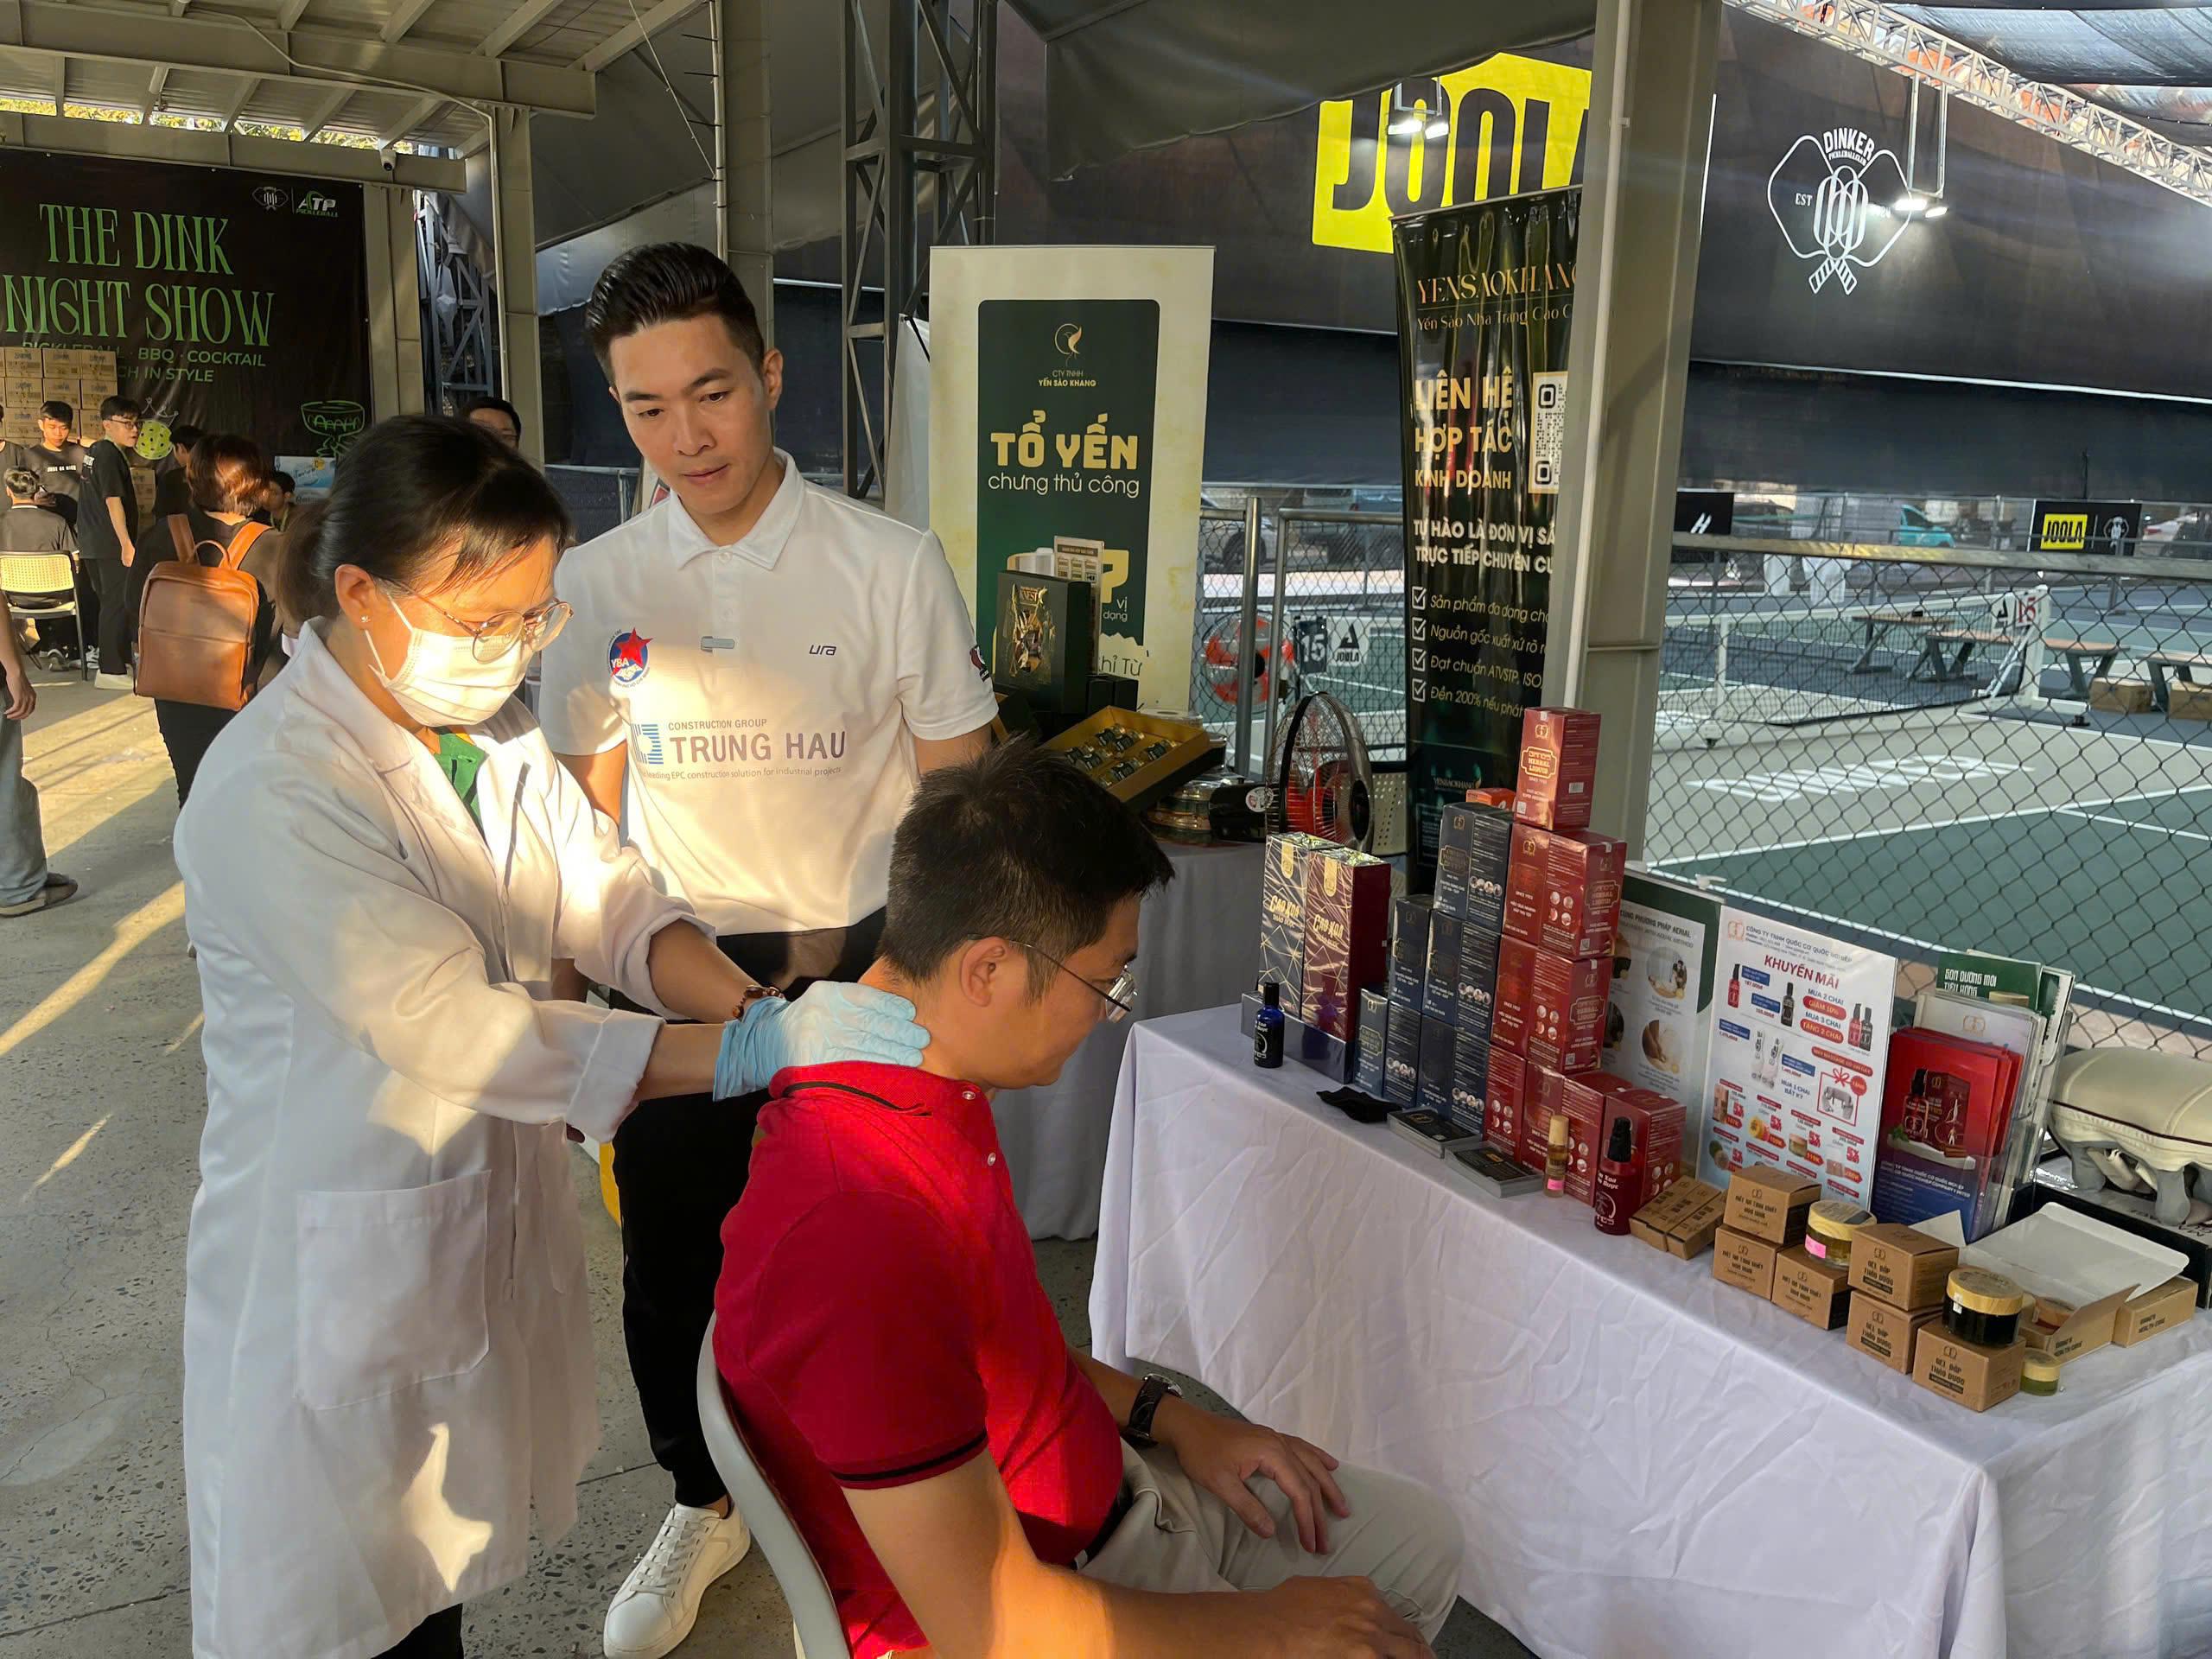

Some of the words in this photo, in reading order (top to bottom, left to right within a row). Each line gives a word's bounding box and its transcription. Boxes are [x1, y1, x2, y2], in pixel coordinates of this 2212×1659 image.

[1332, 78, 1589, 219] JOOL
[1823, 127, 1875, 161] DINKER
[1795, 193, 1813, 207] EST
[39, 203, 121, 267] THE
[132, 211, 234, 276] DINK
[2, 274, 131, 339] NIGHT
[145, 283, 276, 347] SHOW
[1417, 315, 1438, 331] Yến
[1466, 311, 1492, 327] Nha
[1496, 309, 1529, 326] Trang
[1532, 306, 1560, 322] Cao
[138, 347, 175, 364] BBQ
[188, 350, 266, 367] COCKTAIL
[144, 366, 161, 380] IN
[166, 368, 214, 383] STYLE
[1052, 369, 1065, 378] CTY
[1414, 369, 1471, 410] LIÊN
[1482, 365, 1513, 418] HỆ
[991, 410, 1046, 467] TỔ
[1055, 412, 1139, 470] YẾN
[1414, 423, 1463, 461] HỢP
[1469, 418, 1513, 453] TÁC
[988, 473, 1049, 495] chưng
[1053, 471, 1084, 493] thủ
[1088, 472, 1140, 499] công
[1414, 469, 1450, 487] KINH
[1455, 469, 1511, 490] DOANH
[1413, 518, 1428, 541] TỰ
[1431, 516, 1465, 538] HÀO
[1468, 518, 1485, 540] LÀ
[1488, 522, 1516, 543] ĐƠN
[1518, 524, 1534, 550] VỊ
[2043, 519, 2083, 544] JOOLA
[1415, 545, 1448, 567] TRỰC
[1451, 543, 1479, 566] TIẾP
[1483, 551, 1530, 572] CHUYÊN
[1103, 610, 1128, 622] dạng
[1116, 596, 1128, 613] vị
[1430, 594, 1451, 609] Sản
[1452, 595, 1486, 613] phẩm
[1501, 605, 1529, 624] dạng
[2018, 596, 2037, 623] 15
[1430, 623, 1468, 641] Nguồn
[1470, 629, 1491, 645] gốc
[1300, 633, 1325, 663] 15
[610, 657, 630, 668] YBA
[1099, 655, 1121, 674] hỉ
[1430, 655, 1452, 672] Đạt
[1452, 658, 1486, 676] chuẩn
[1455, 690, 1481, 706] 200%
[668, 719, 732, 731] CONSTRUCTION
[734, 718, 767, 729] GROUP
[670, 733, 772, 765] TRUNG
[785, 730, 846, 760] HAU
[671, 771, 686, 779] EPC
[687, 769, 730, 779] construction
[730, 768, 762, 779] solution
[763, 766, 775, 776] for
[776, 766, 812, 776] industrial
[1764, 955, 1814, 982] KHUYẾN
[1815, 972, 1840, 989] MÃI
[1808, 988, 1822, 998] MUA
[1828, 994, 1845, 1006] CHAI
[1805, 1011, 1820, 1022] MUA
[1826, 1018, 1841, 1030] CHAI
[1826, 1030, 1842, 1041] CHAI
